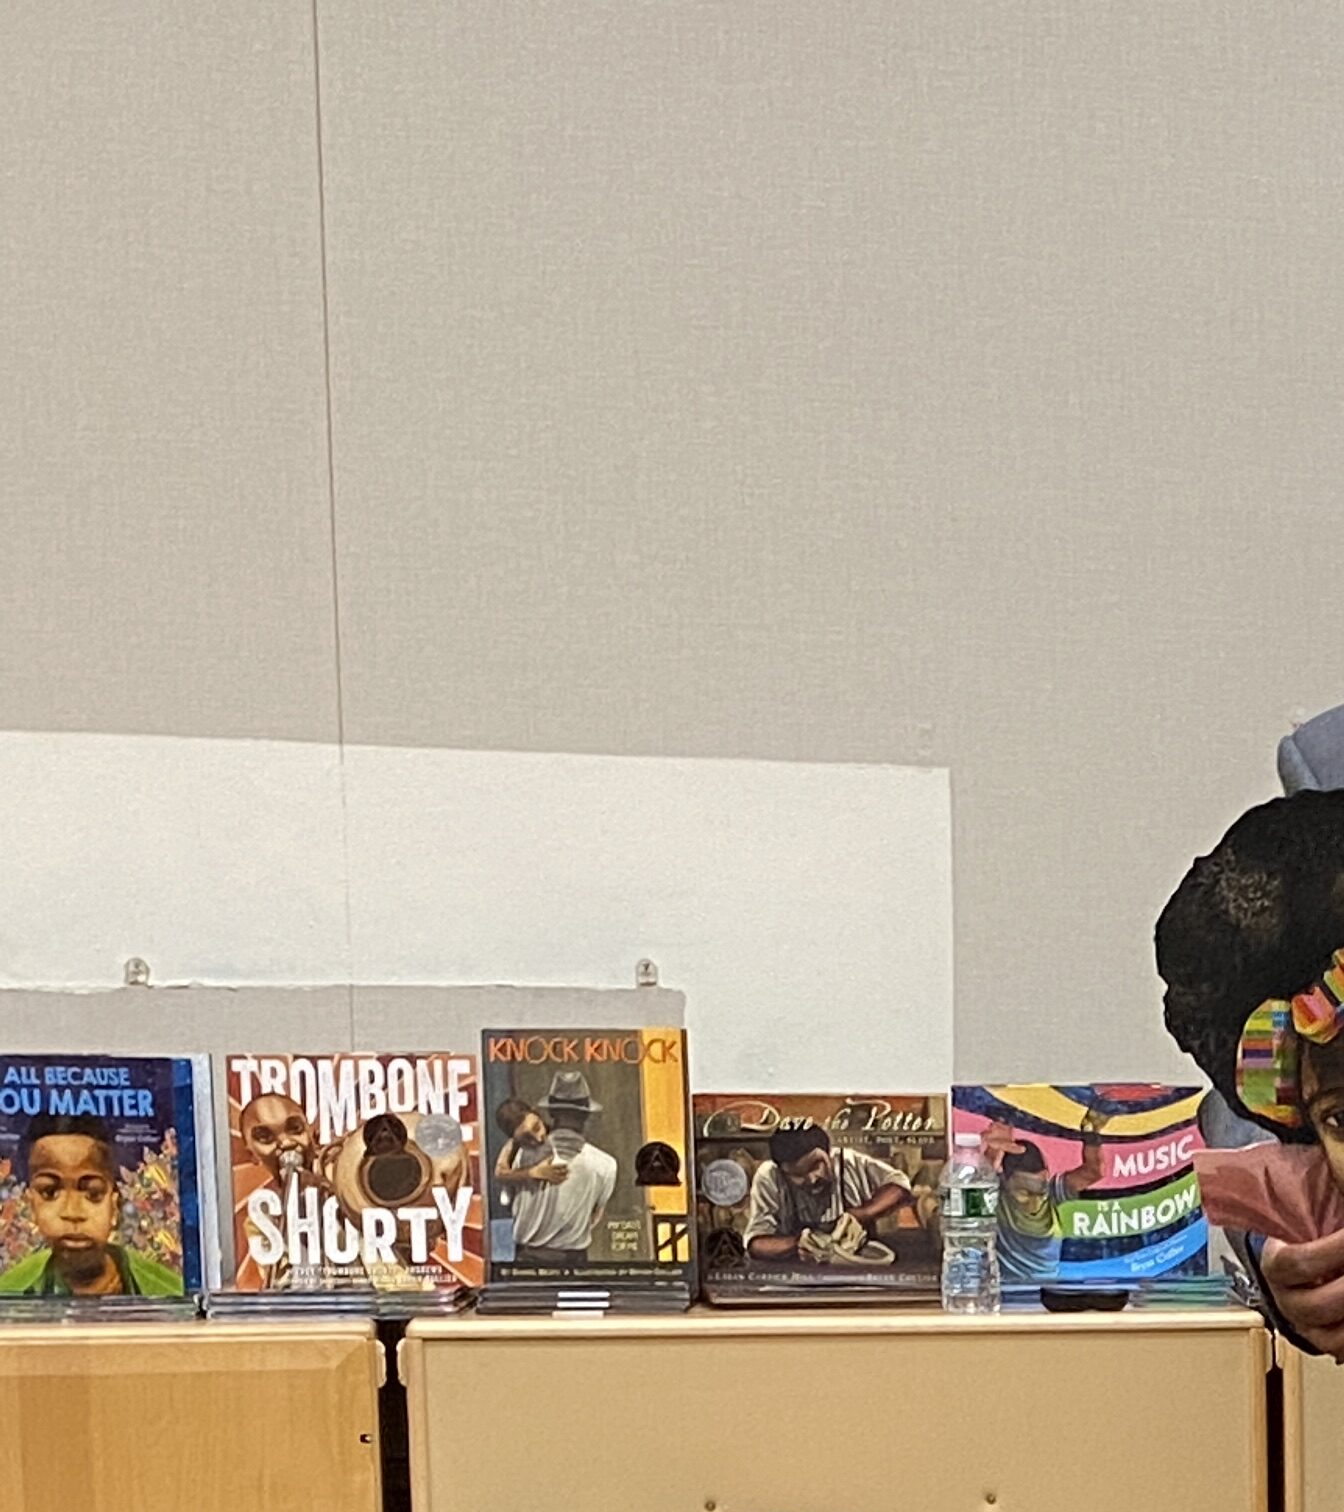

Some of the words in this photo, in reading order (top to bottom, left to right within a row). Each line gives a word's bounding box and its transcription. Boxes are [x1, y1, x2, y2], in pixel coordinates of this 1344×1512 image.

[489, 1037, 579, 1063] KNOCK
[585, 1037, 679, 1064] KNOCK
[4, 1066, 41, 1085] ALL
[44, 1066, 131, 1086] BECAUSE
[50, 1088, 155, 1117] MATTER
[230, 1058, 474, 1143] TROMBONE
[845, 1098, 938, 1131] Potter
[1112, 1134, 1194, 1178] MUSIC
[1073, 1184, 1196, 1236] RAINBOW
[1097, 1201, 1109, 1211] IS
[1112, 1200, 1121, 1210] A
[247, 1187, 474, 1265] SHORTY
